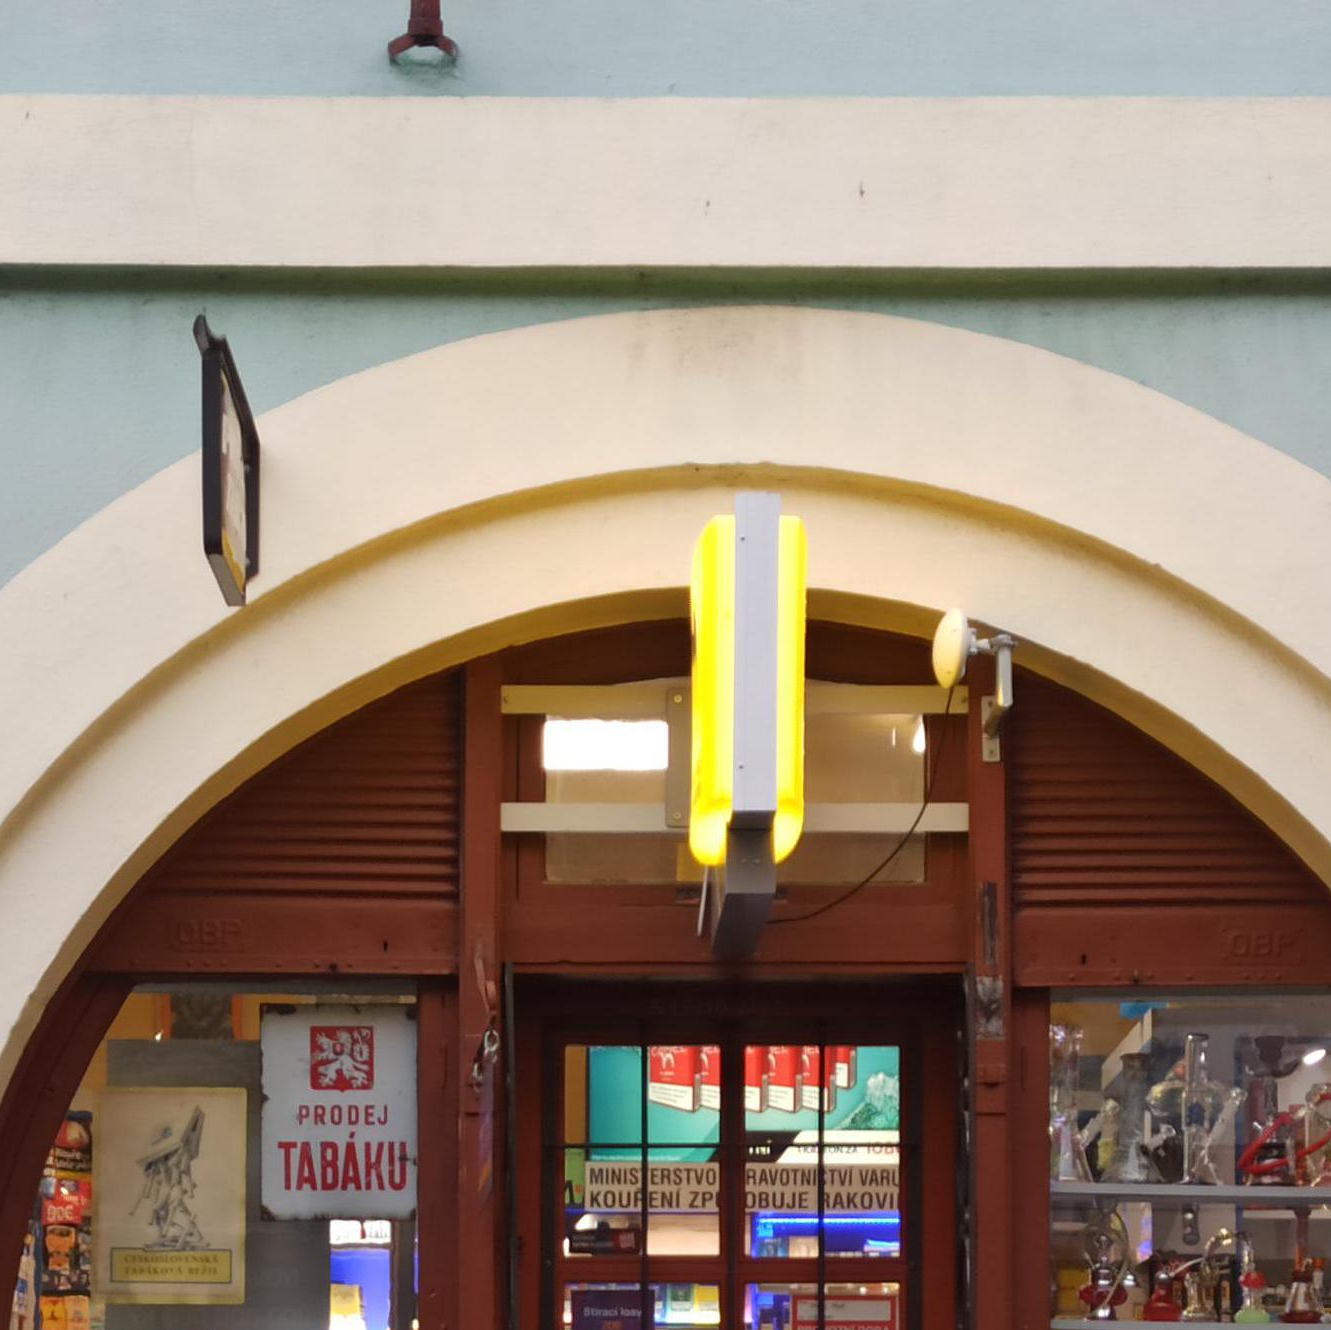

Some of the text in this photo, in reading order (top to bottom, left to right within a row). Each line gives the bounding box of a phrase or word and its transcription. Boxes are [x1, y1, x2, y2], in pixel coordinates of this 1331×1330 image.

[297, 1104, 389, 1126] PRODEJ
[277, 1132, 408, 1191] TABÁKU
[589, 1167, 717, 1186] MINISERSTVO
